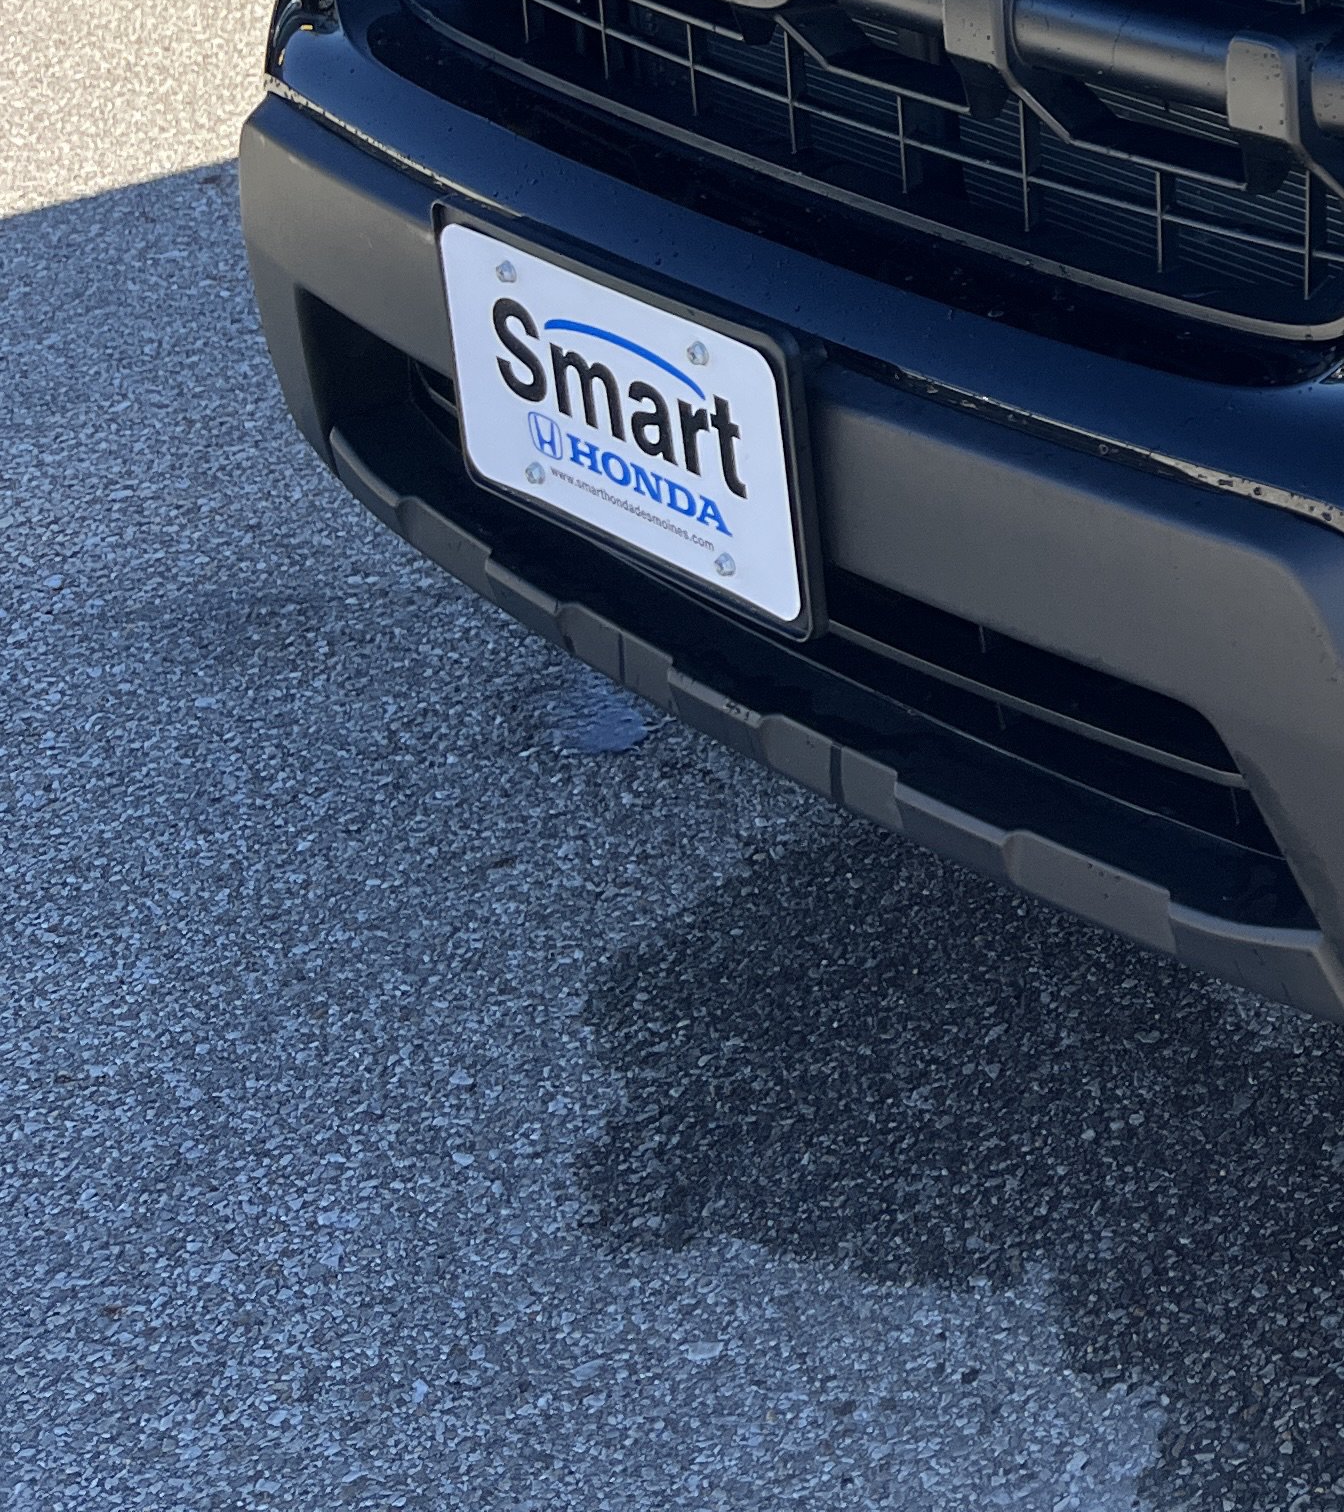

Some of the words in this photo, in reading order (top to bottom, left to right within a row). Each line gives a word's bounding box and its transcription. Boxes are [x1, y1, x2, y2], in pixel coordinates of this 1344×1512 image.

[492, 297, 748, 499] Smart
[550, 466, 715, 552] www.smarthondadesmoines.com
[566, 433, 733, 538] HONDA
